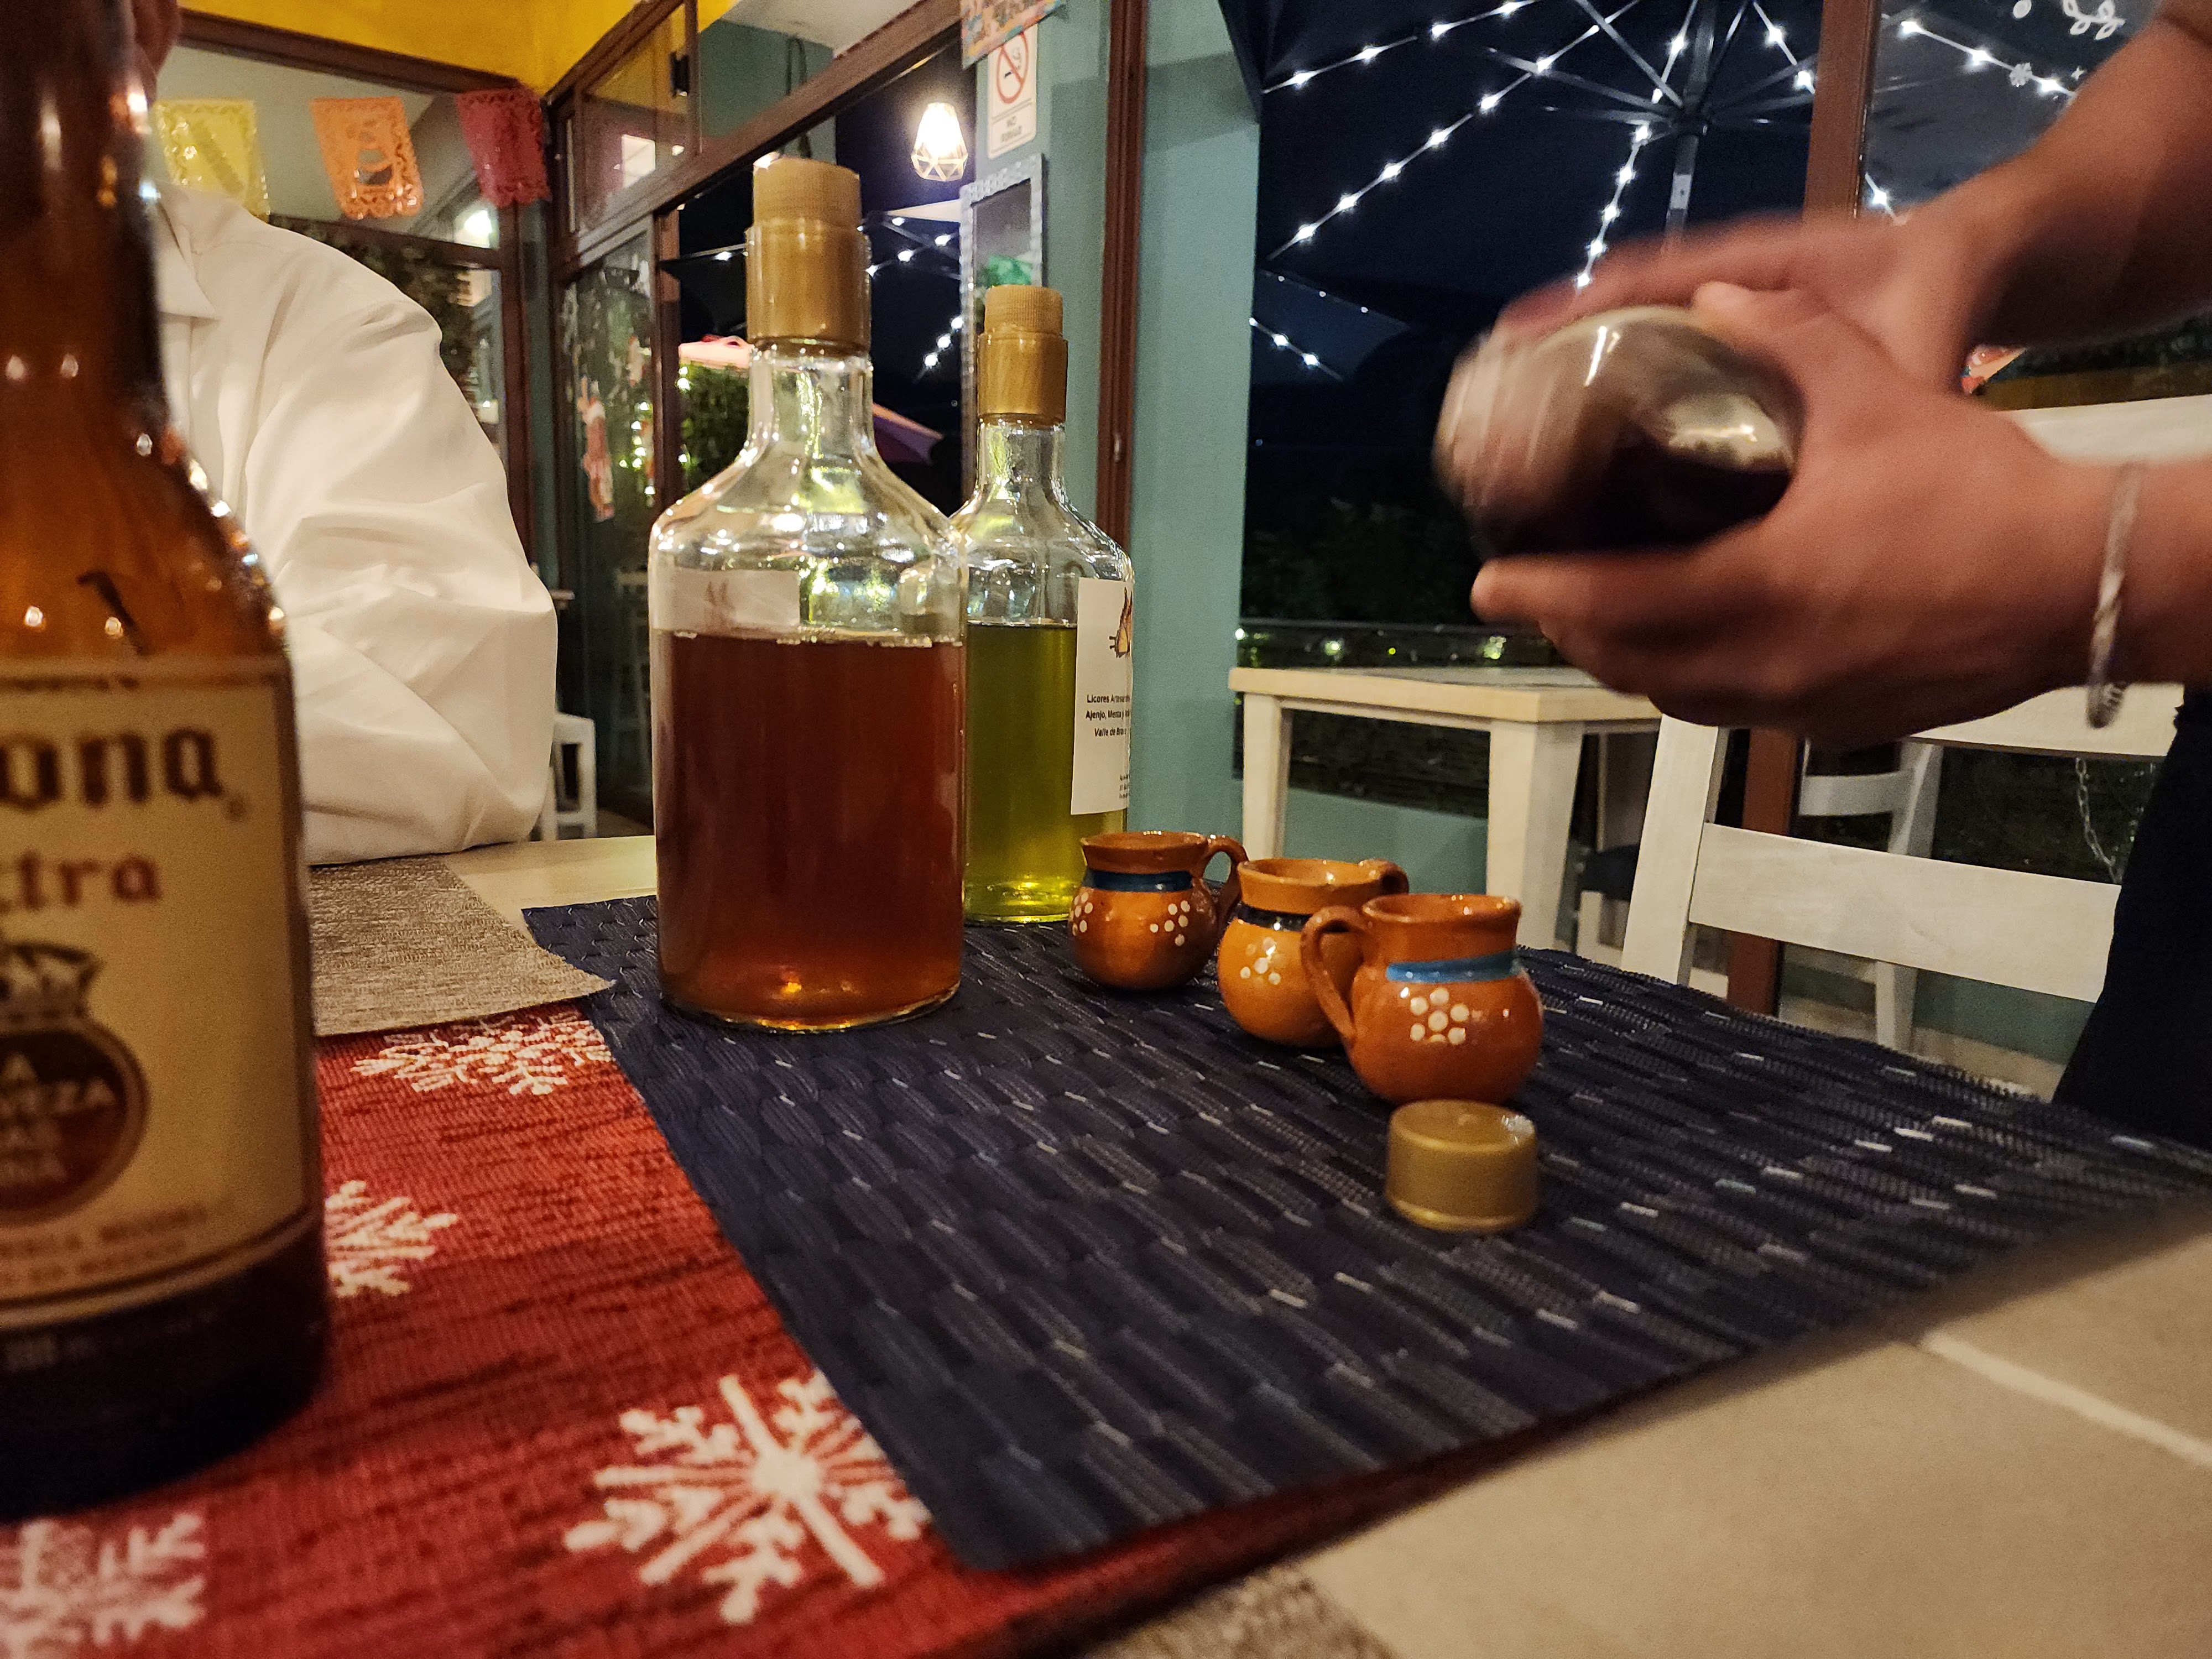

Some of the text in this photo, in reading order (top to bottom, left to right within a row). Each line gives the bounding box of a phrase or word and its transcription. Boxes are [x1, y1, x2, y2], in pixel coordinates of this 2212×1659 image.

[1087, 694, 1109, 703] Licores
[1086, 710, 1107, 721] Ajenjo,
[1094, 728, 1109, 737] Valle
[1109, 727, 1116, 736] de
[0, 851, 163, 911] tra
